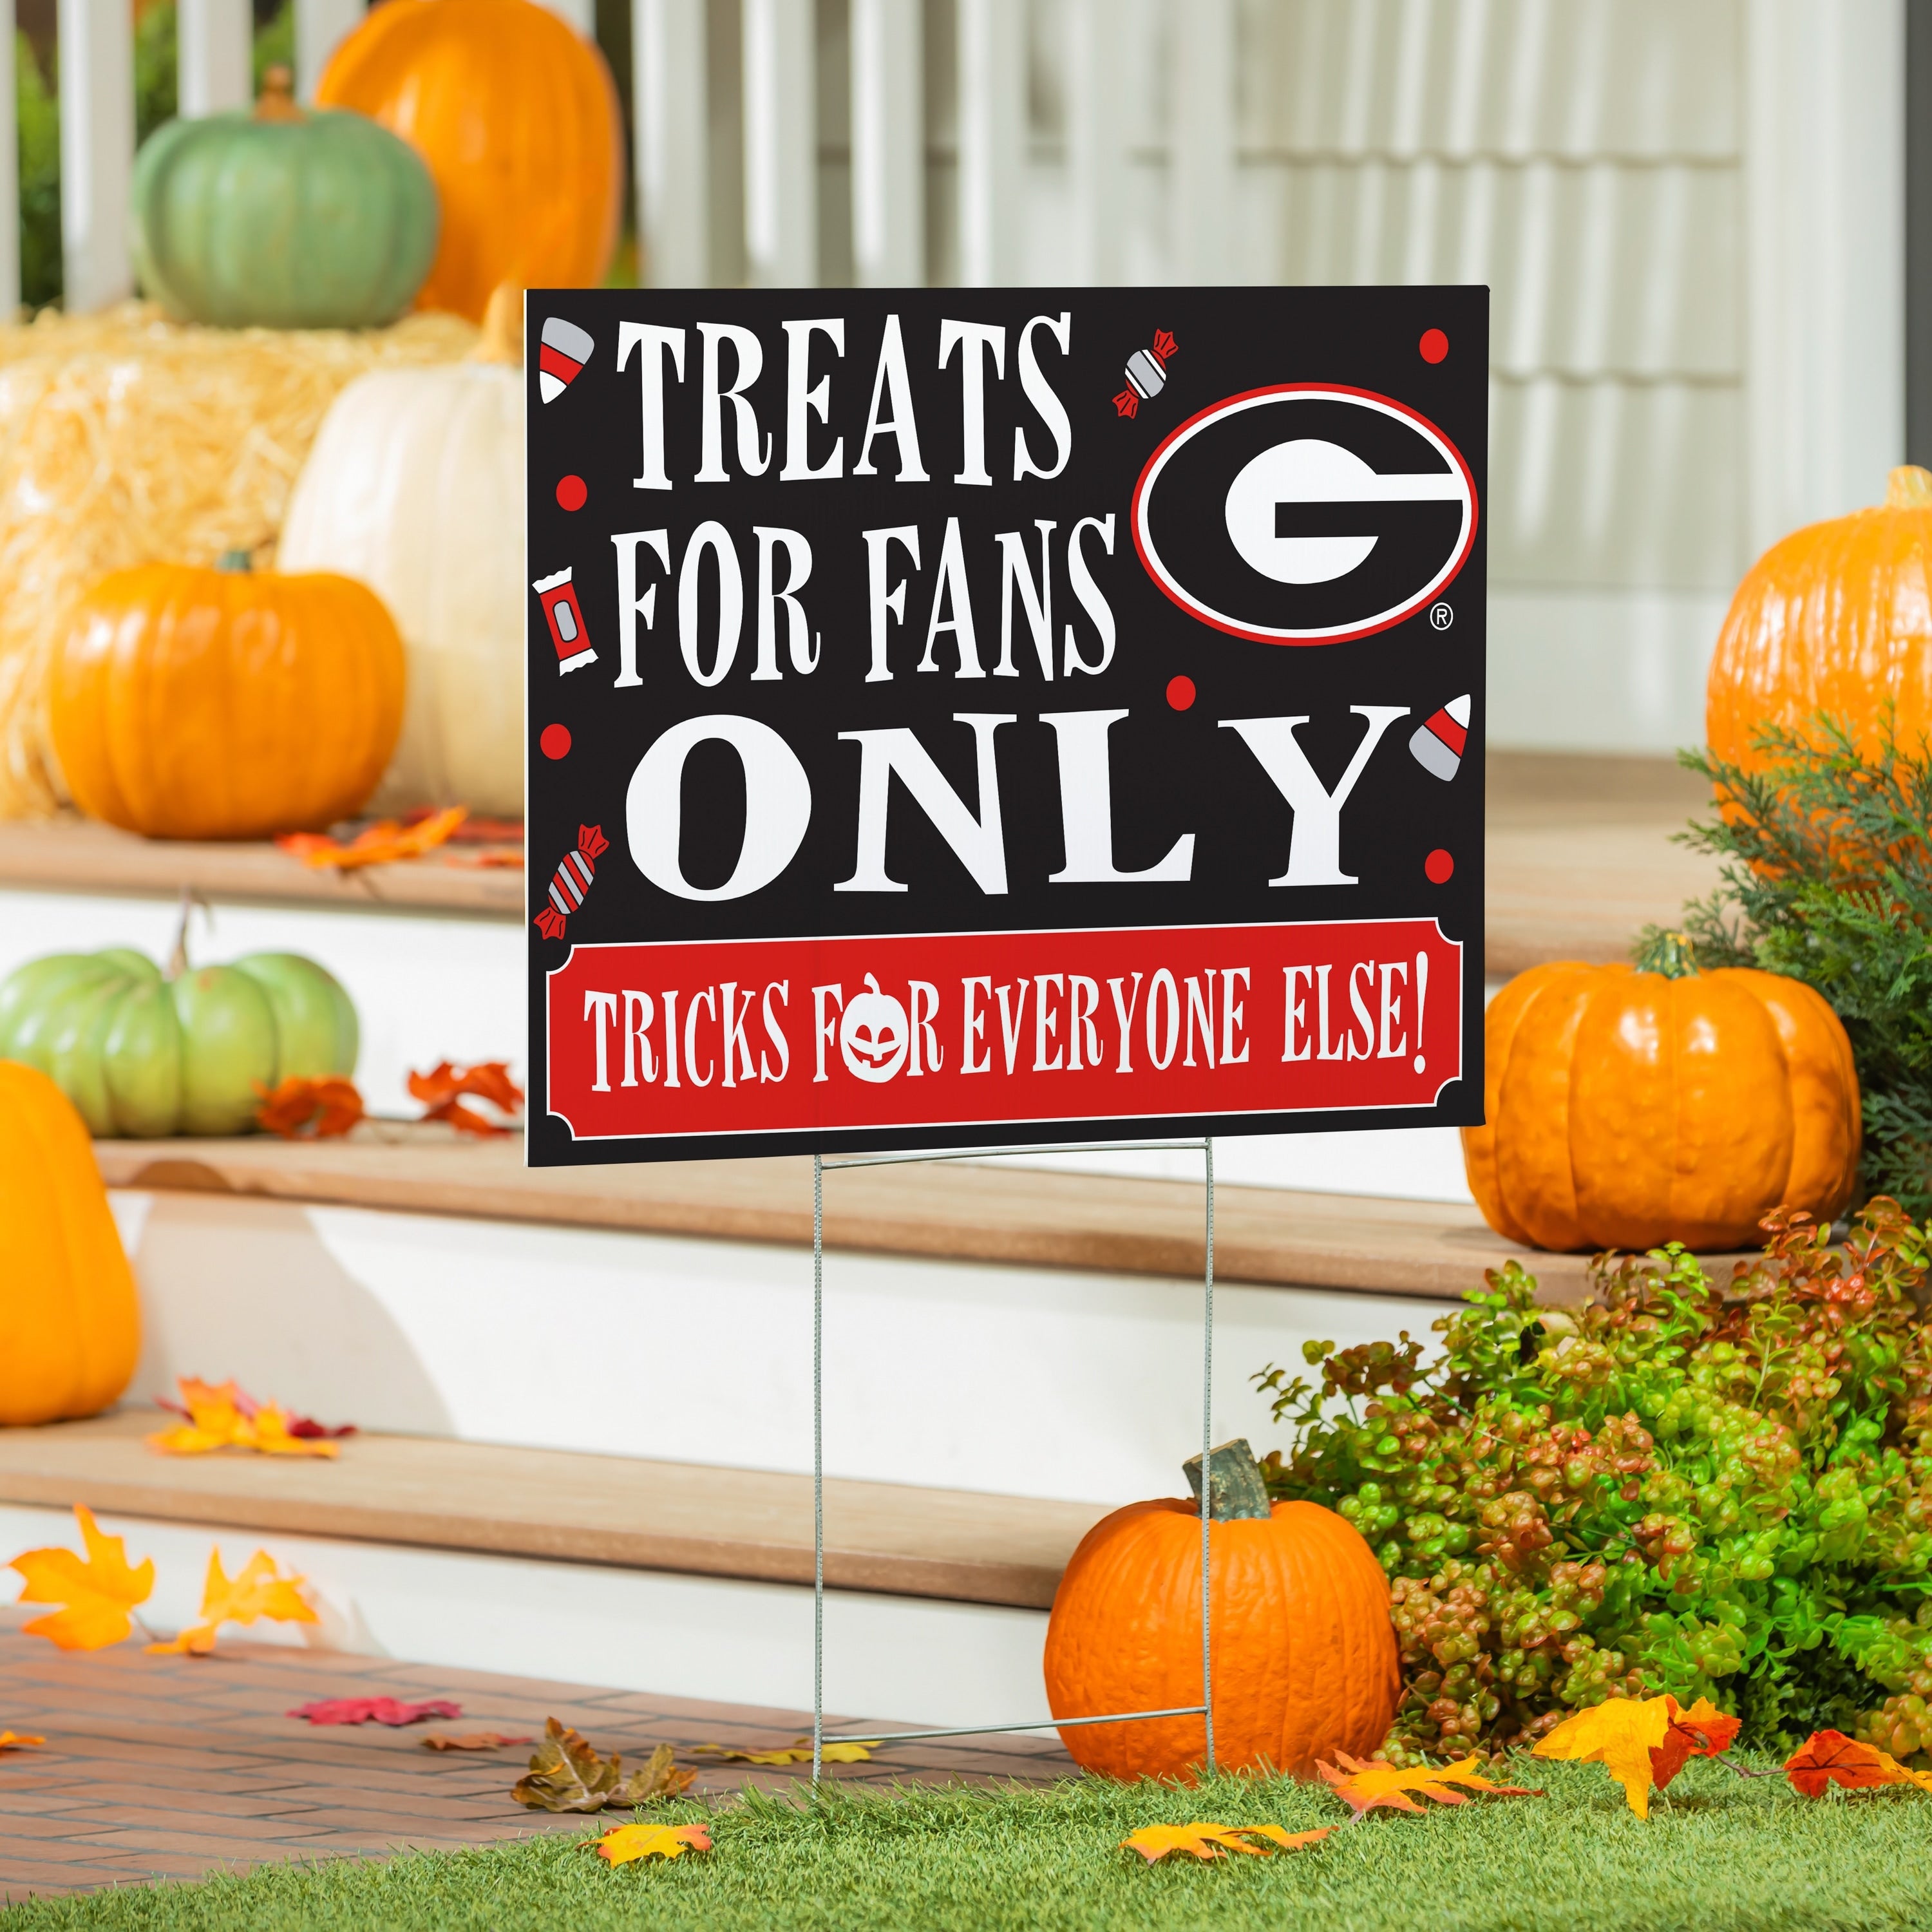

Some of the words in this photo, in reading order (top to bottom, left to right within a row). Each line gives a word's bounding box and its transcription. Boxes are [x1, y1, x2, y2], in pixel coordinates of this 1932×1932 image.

[616, 312, 1073, 491] TREATS
[611, 520, 821, 688] FOR
[862, 513, 1116, 683] FANS
[625, 705, 1411, 902] ONLY
[583, 979, 790, 1093] TRICKS
[960, 967, 1251, 1077] EVERYONE
[1281, 948, 1430, 1075] ELSE!
